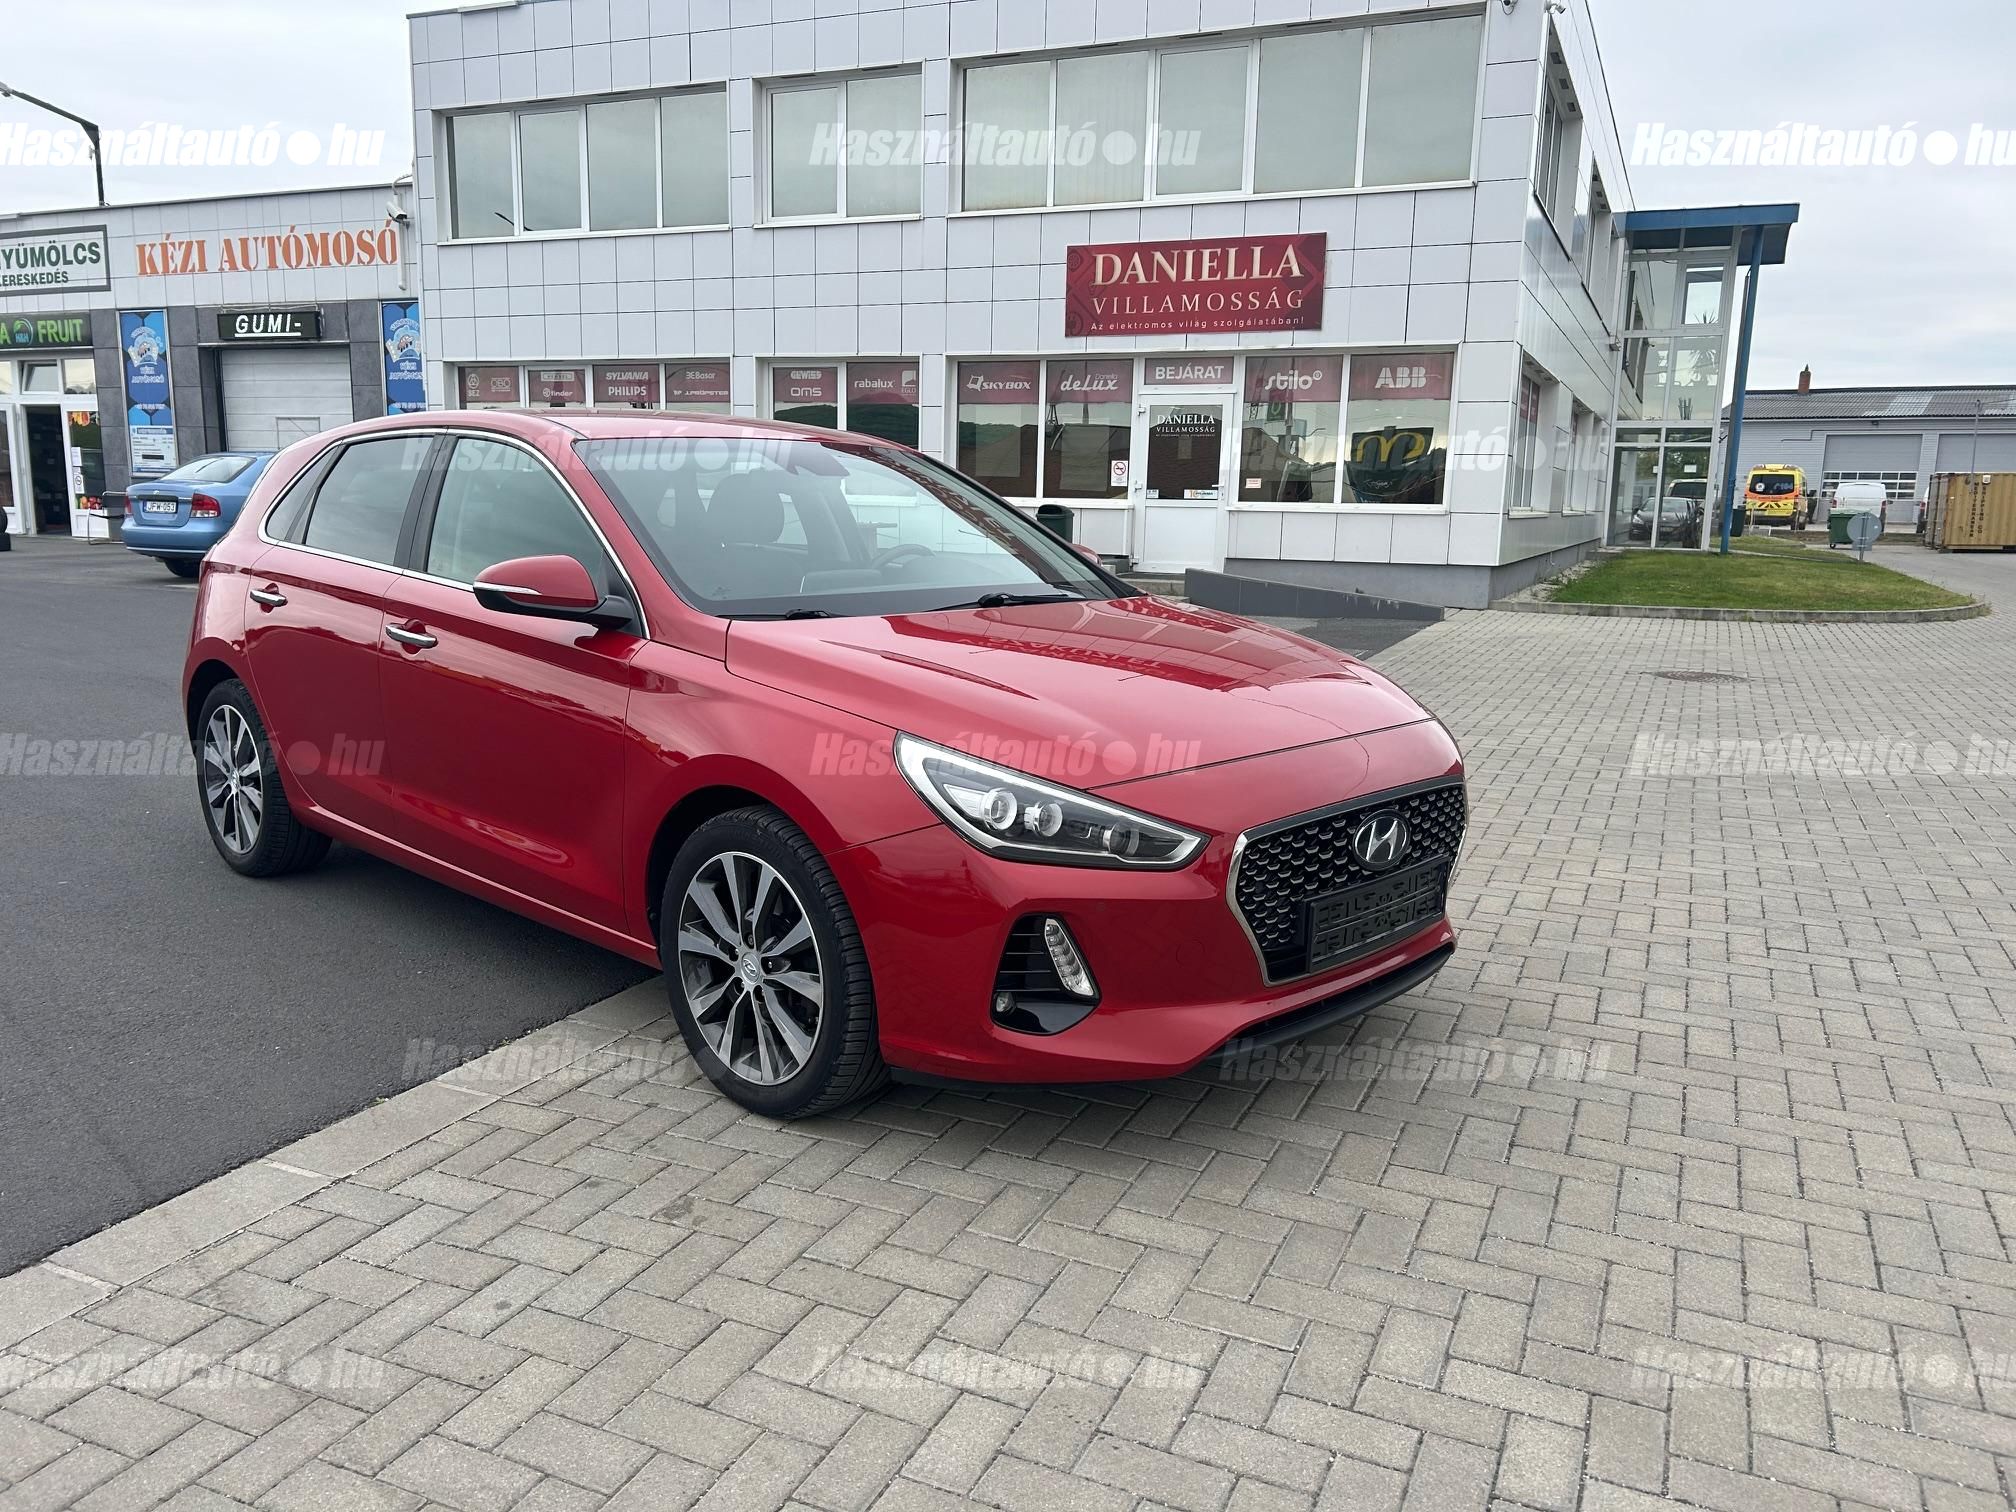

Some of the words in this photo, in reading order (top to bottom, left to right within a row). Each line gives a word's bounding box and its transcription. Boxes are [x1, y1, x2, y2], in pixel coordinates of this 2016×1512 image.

[0, 240, 101, 270] YÜMÖLCS
[136, 233, 208, 276] KÉZI
[218, 218, 398, 272] AUTÓMOSÓ
[1091, 243, 1305, 287] DANIELLA
[0, 268, 69, 287] ERESKEDÉS
[1092, 286, 1303, 316] VILLAMOSSÁG
[37, 319, 83, 343] FRUIT
[235, 314, 302, 334] GUMI-
[1091, 323, 1104, 331] Az
[1109, 320, 1174, 330] elektromos
[1178, 317, 1208, 329] világ
[1213, 316, 1305, 327] szolgálatában!
[605, 371, 649, 380] SYLVANIA
[1155, 362, 1225, 380] BEJÁRAT
[1264, 369, 1313, 391] stilo
[1375, 366, 1427, 388] ABB
[608, 386, 647, 396] PHILIPS
[854, 378, 894, 388] rabalux
[981, 380, 1032, 390] SKYBOX
[1156, 425, 1216, 433] VILLAMOSSÁG
[1157, 414, 1215, 425] DANIELLA
